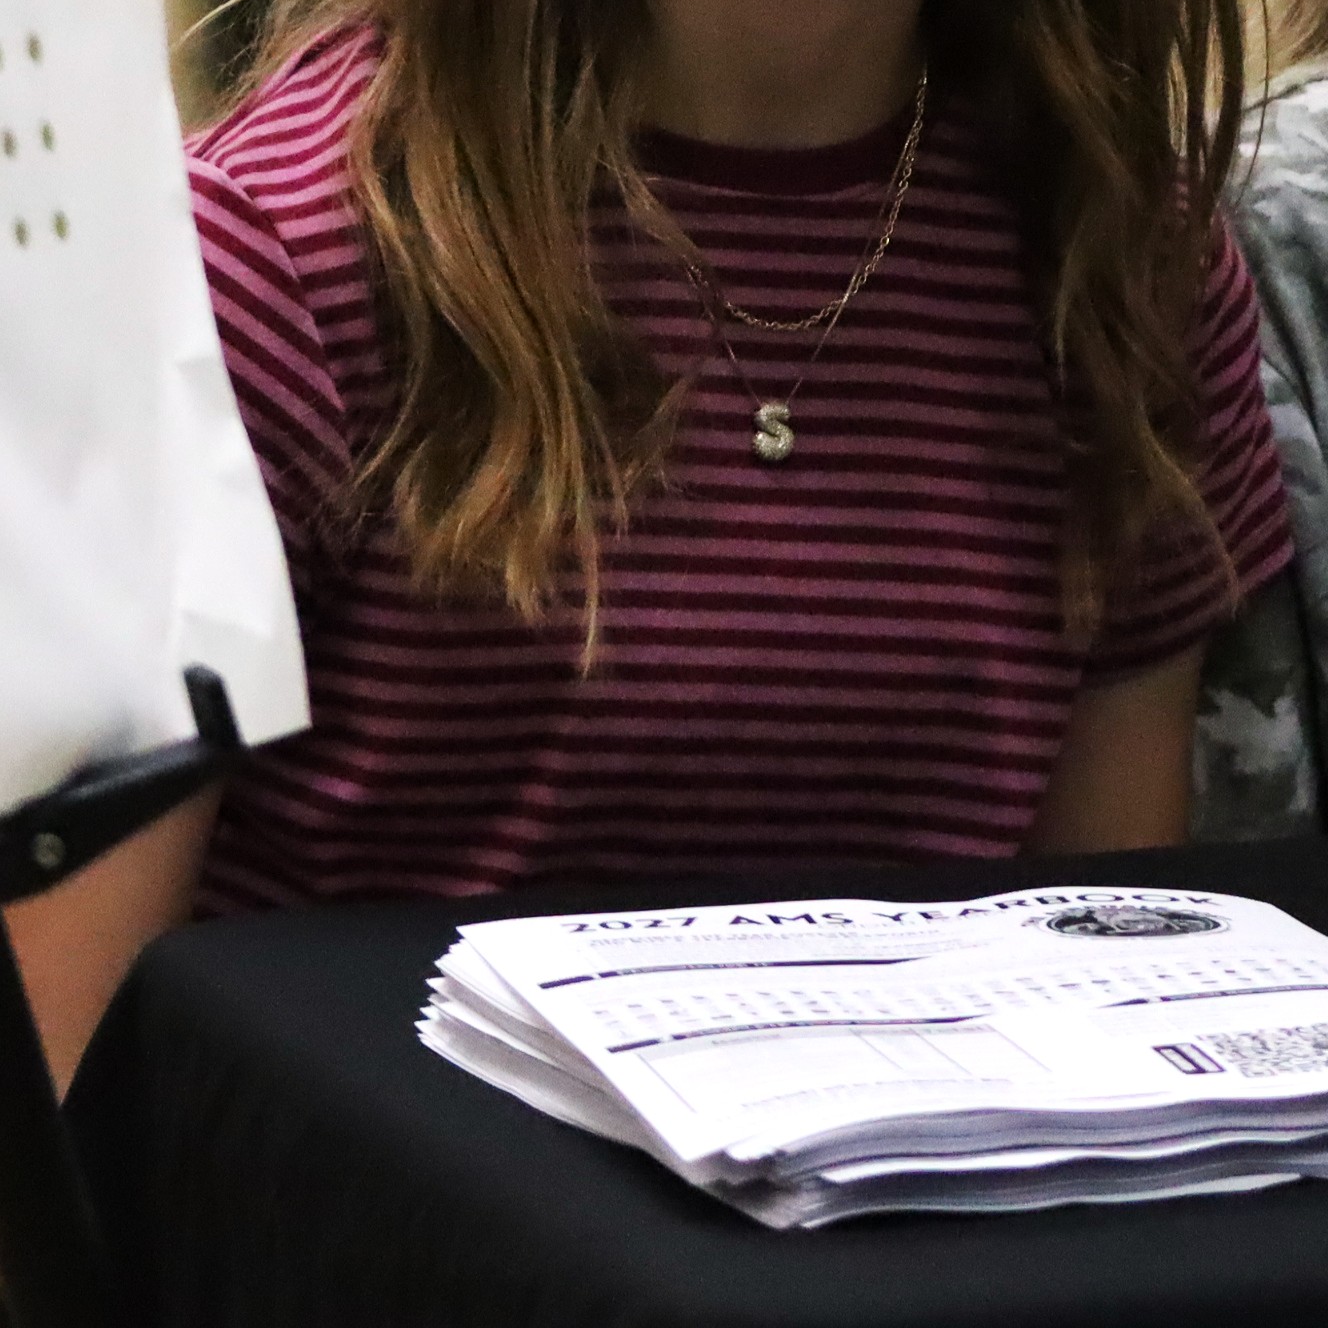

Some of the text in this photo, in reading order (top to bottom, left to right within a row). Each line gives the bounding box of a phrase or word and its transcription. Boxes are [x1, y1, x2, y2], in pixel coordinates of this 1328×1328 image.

[752, 400, 796, 462] S
[561, 915, 699, 933] 2027
[728, 912, 854, 926] AMS
[872, 892, 1222, 923] YEARBOOK
